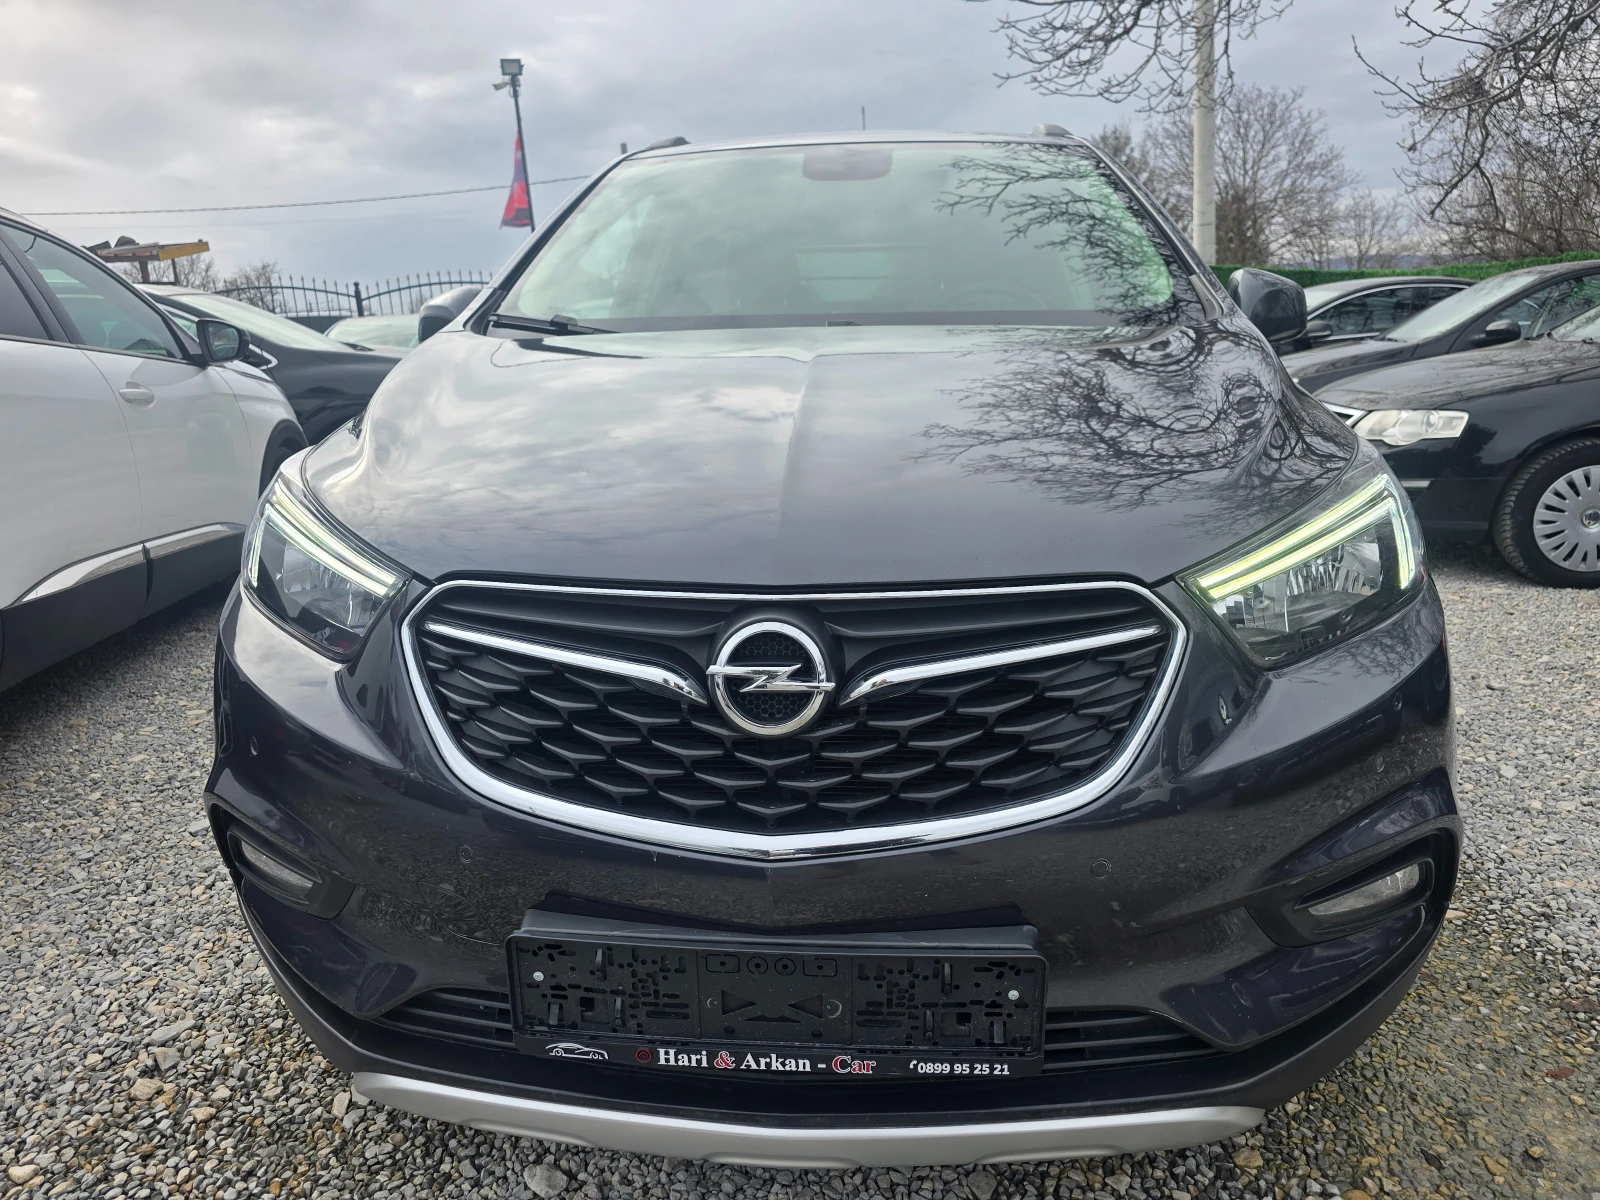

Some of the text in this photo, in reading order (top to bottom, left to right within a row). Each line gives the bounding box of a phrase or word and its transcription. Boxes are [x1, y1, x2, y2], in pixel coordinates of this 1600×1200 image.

[657, 1048, 708, 1067] Hari
[714, 1051, 736, 1069] &
[740, 1052, 812, 1072] Arkan
[832, 1055, 877, 1074] Car
[917, 1062, 1010, 1075] 0899 95 25 21
